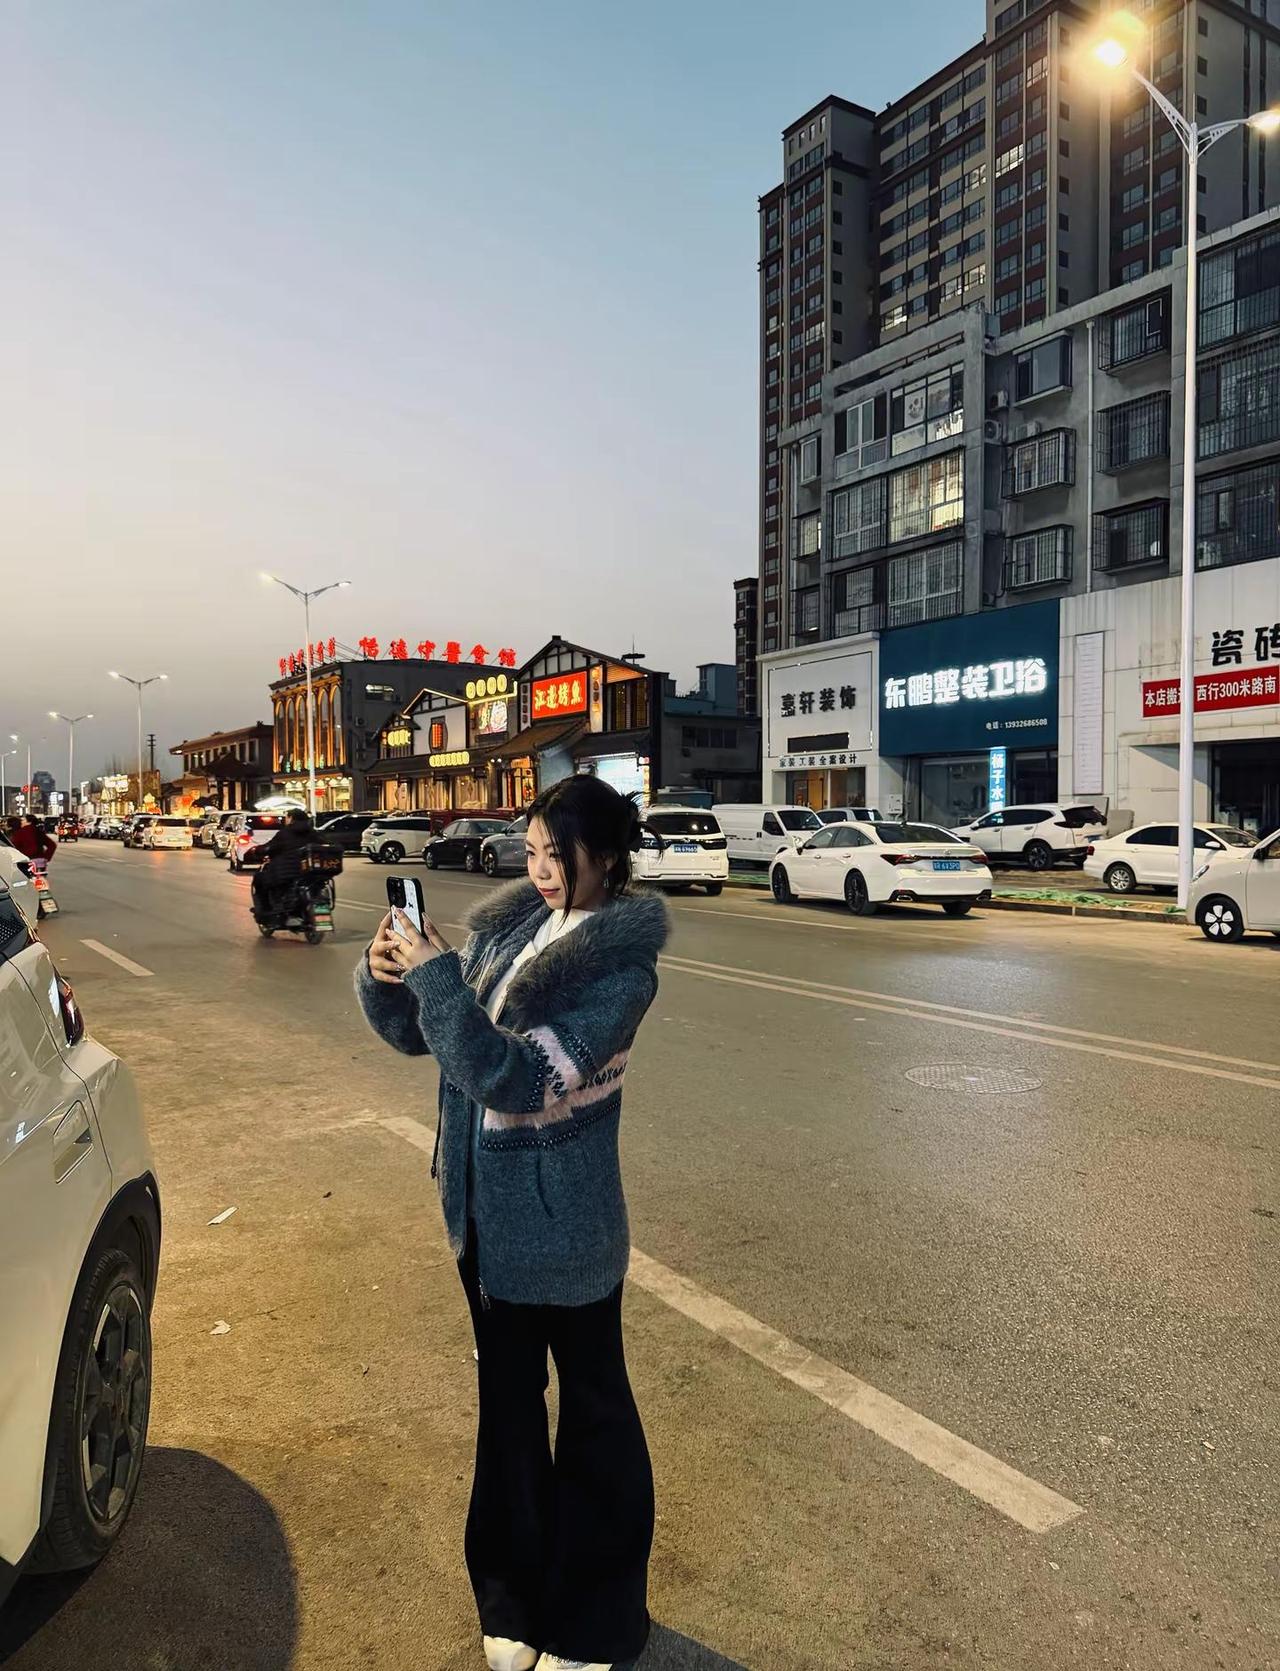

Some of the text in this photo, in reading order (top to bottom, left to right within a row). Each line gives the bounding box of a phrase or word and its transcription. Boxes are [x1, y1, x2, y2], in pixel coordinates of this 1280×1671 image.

[1211, 623, 1280, 667] 瓷砖
[885, 657, 1048, 709] 东鹏整装卫浴
[1196, 675, 1277, 701] 西行300米路南
